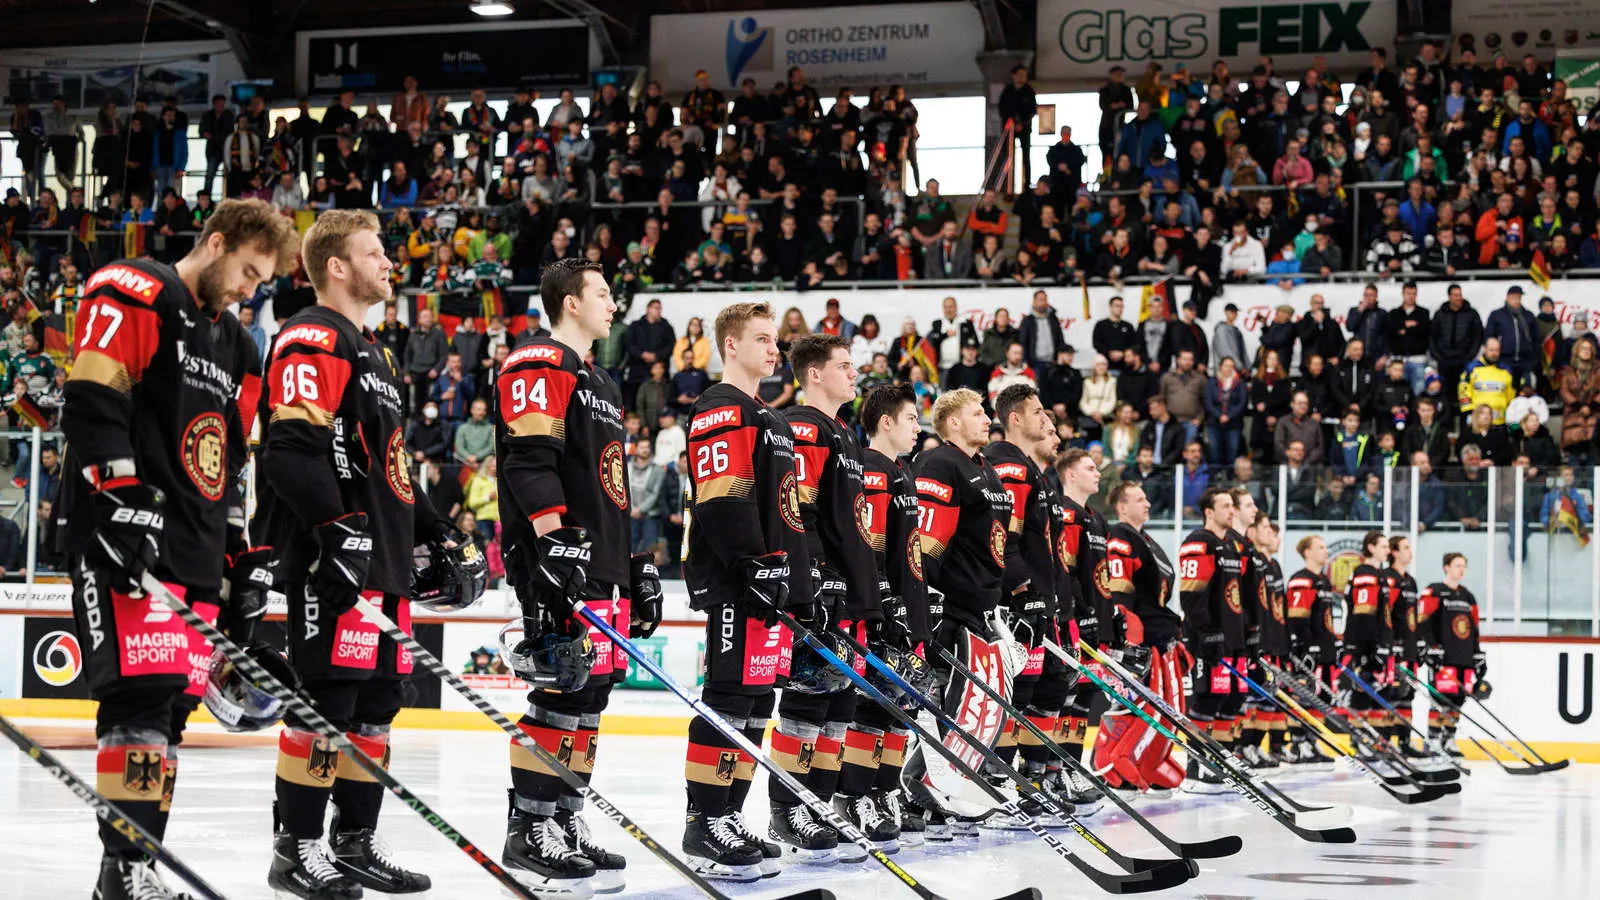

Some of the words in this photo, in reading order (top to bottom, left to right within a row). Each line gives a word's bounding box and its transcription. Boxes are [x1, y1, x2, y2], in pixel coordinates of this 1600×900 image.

[786, 27, 843, 45] ORTHO
[848, 23, 930, 43] ZENTRUM
[1059, 10, 1207, 63] Glas
[1219, 1, 1373, 56] FEIX
[786, 46, 887, 65] ROSENHEIM
[504, 348, 557, 368] PENNY.
[282, 363, 319, 405] 86
[511, 377, 547, 414] 94
[690, 409, 737, 434] PENNY.
[697, 440, 729, 479] 26
[81, 557, 105, 651] KODA
[127, 648, 176, 665] SPORT
[337, 645, 374, 660] SPORT
[749, 666, 777, 677] SPORT
[1557, 652, 1594, 725] U
[49, 765, 111, 820] ALPHA
[111, 818, 143, 843] LX
[576, 786, 625, 826] ALPHA
[624, 823, 647, 842] LX
[403, 796, 462, 846] ALPHA
[460, 843, 489, 867] LX
[1003, 801, 1072, 857] BAUER
